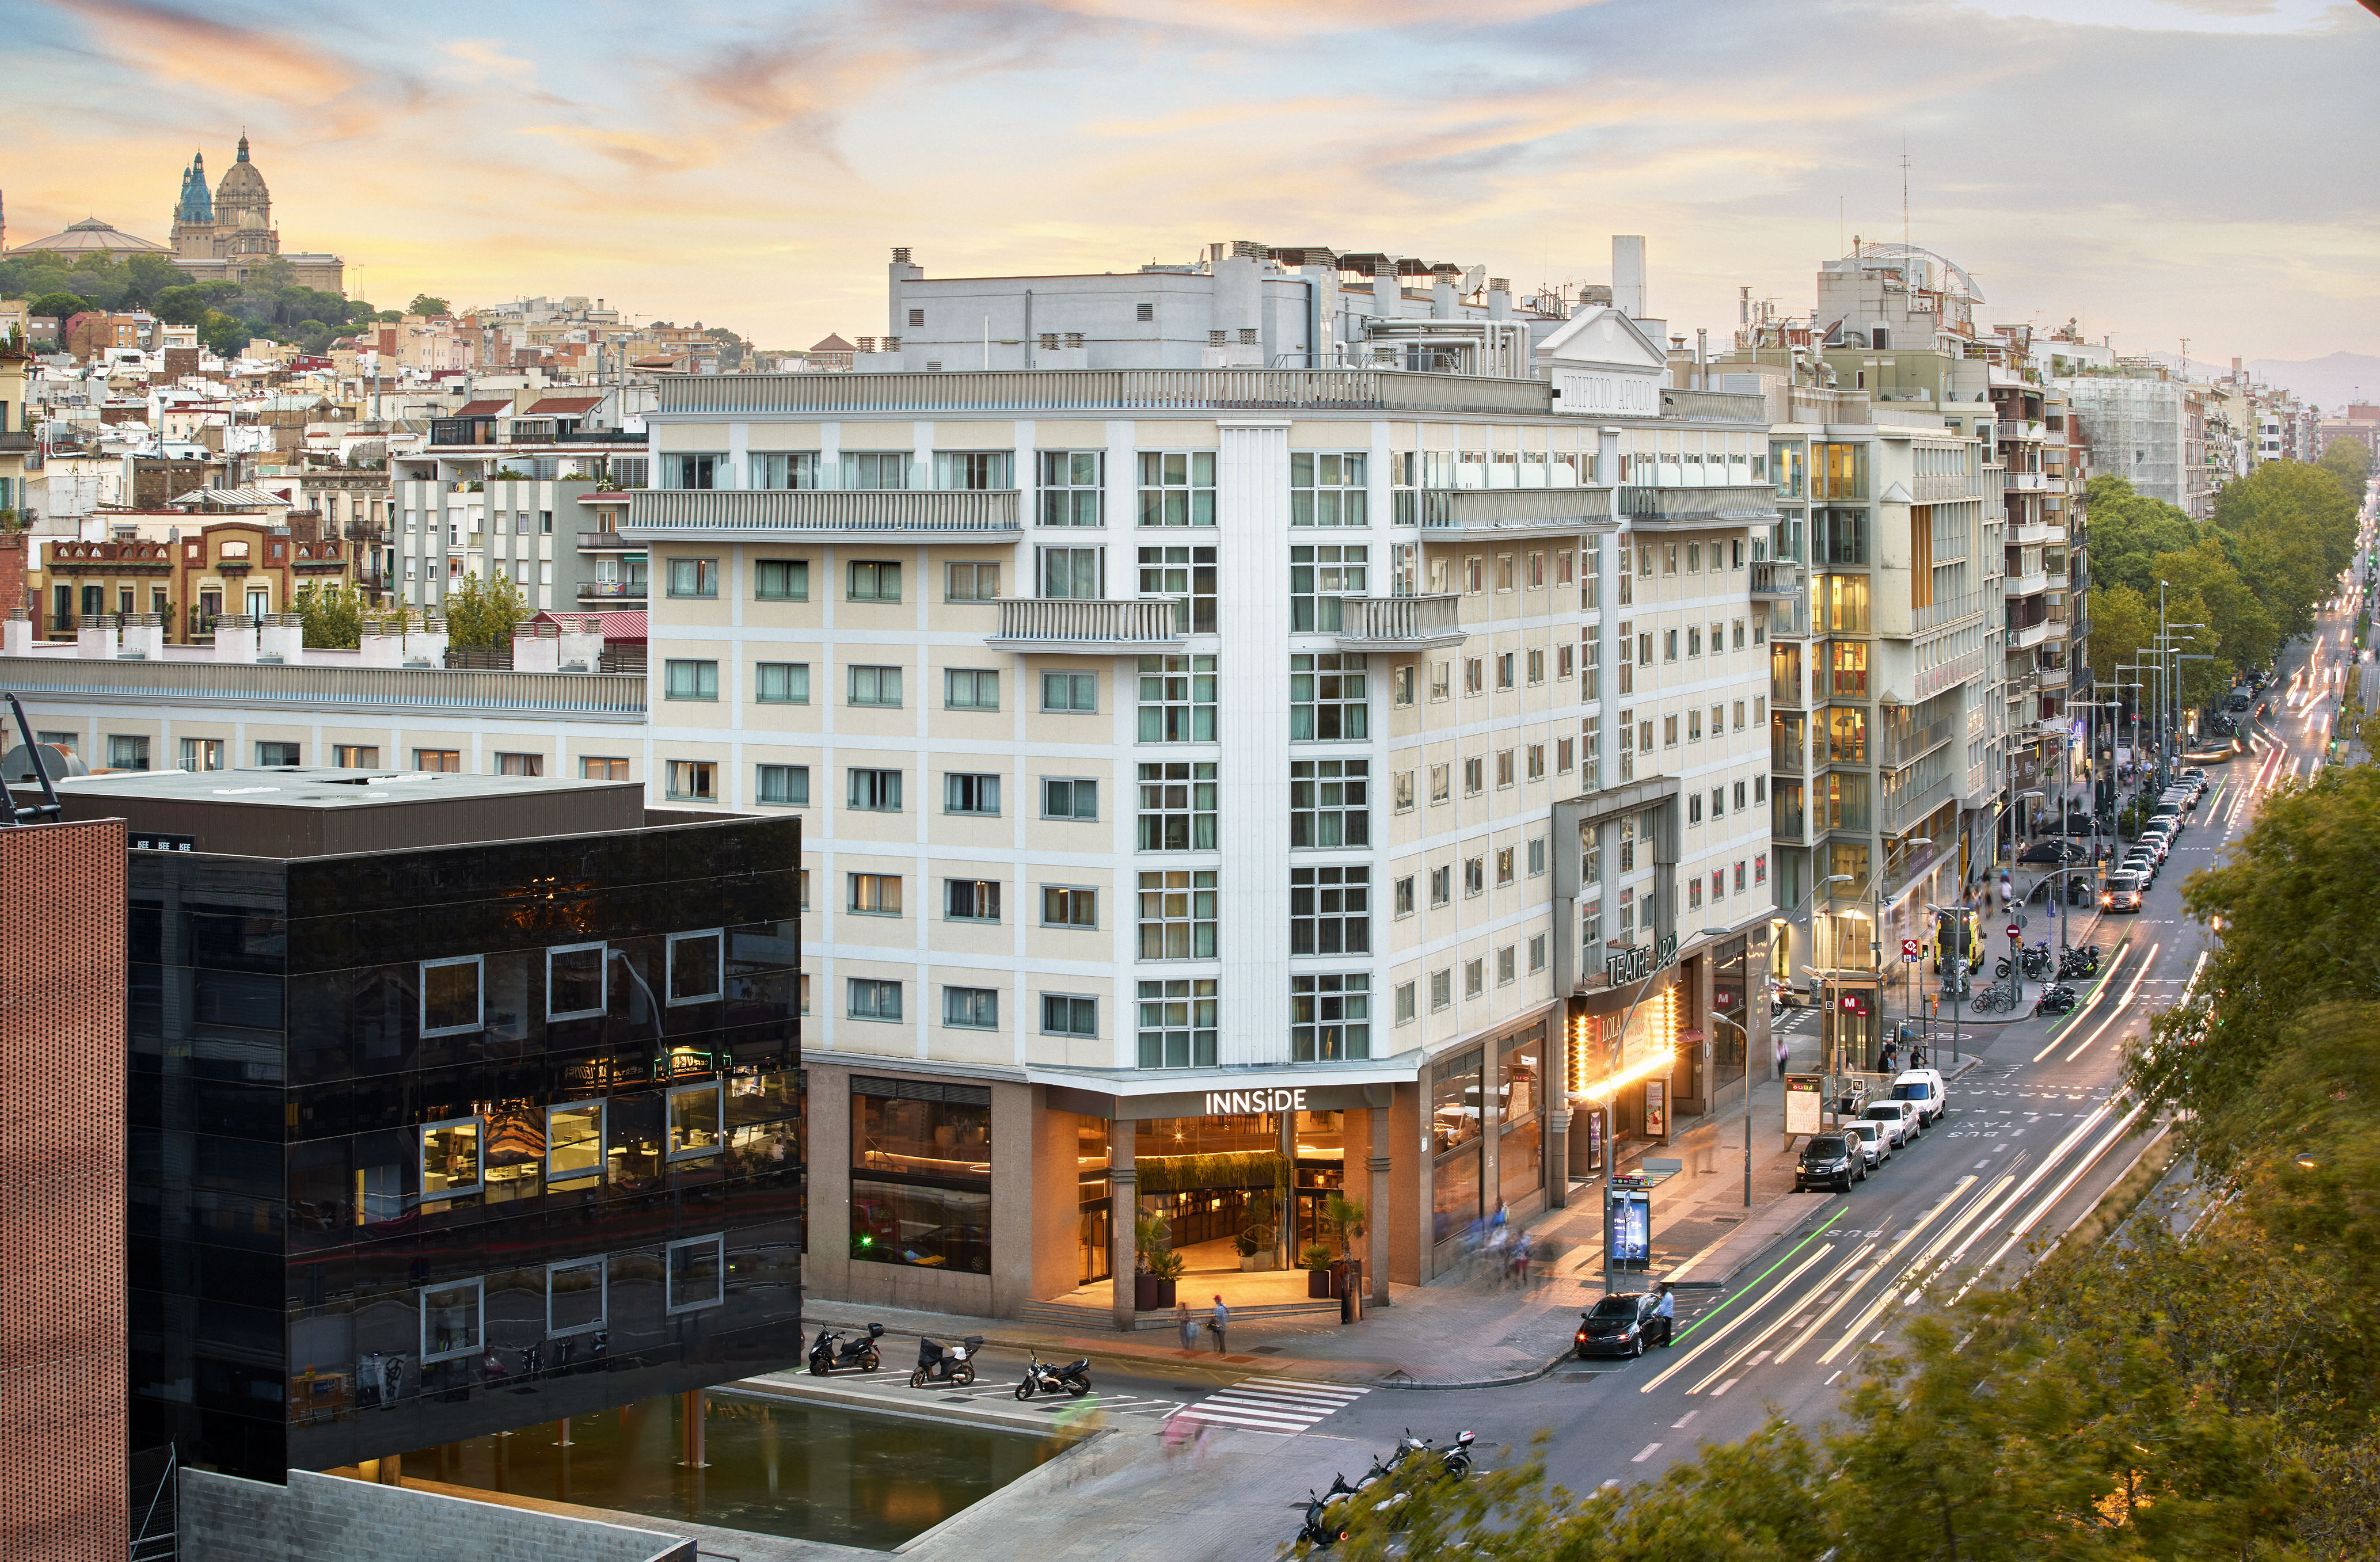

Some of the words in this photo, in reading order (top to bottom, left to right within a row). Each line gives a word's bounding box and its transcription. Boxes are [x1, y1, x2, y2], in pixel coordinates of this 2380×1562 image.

[1563, 375, 1611, 409] EDIFICIO
[1618, 380, 1651, 410] APOLO
[1607, 945, 1651, 988] TEATRE
[1718, 993, 1728, 1003] M
[1845, 998, 1855, 1007] M
[1602, 1014, 1621, 1042] LOLA
[1824, 1229, 1884, 1237] BUS
